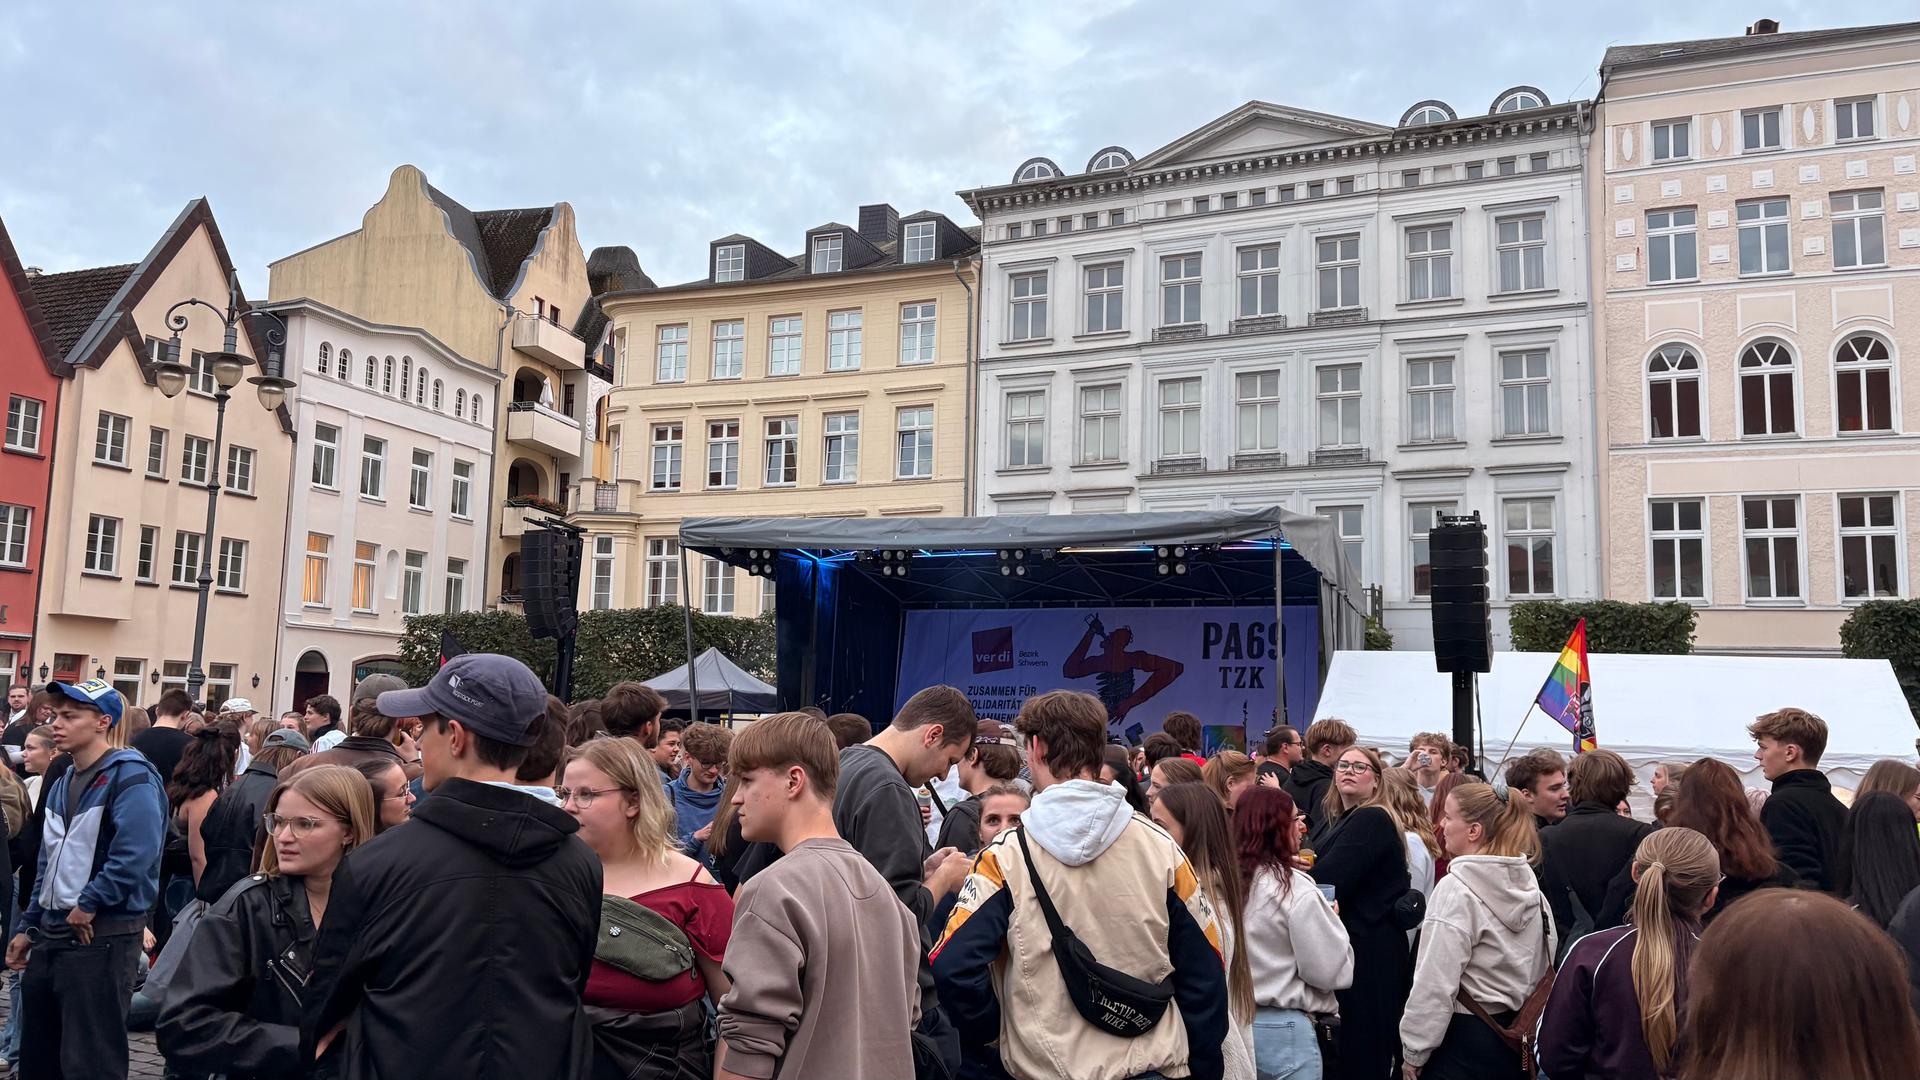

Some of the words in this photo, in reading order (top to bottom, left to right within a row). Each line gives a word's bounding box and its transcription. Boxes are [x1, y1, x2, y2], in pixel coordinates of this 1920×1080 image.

[1202, 621, 1286, 660] PA69
[1018, 650, 1039, 658] Bezirk
[1218, 666, 1264, 689] TZK
[967, 686, 1016, 696] ZUSAMMEN
[1019, 684, 1037, 696] FÜR
[1101, 1012, 1128, 1030] NIKE
